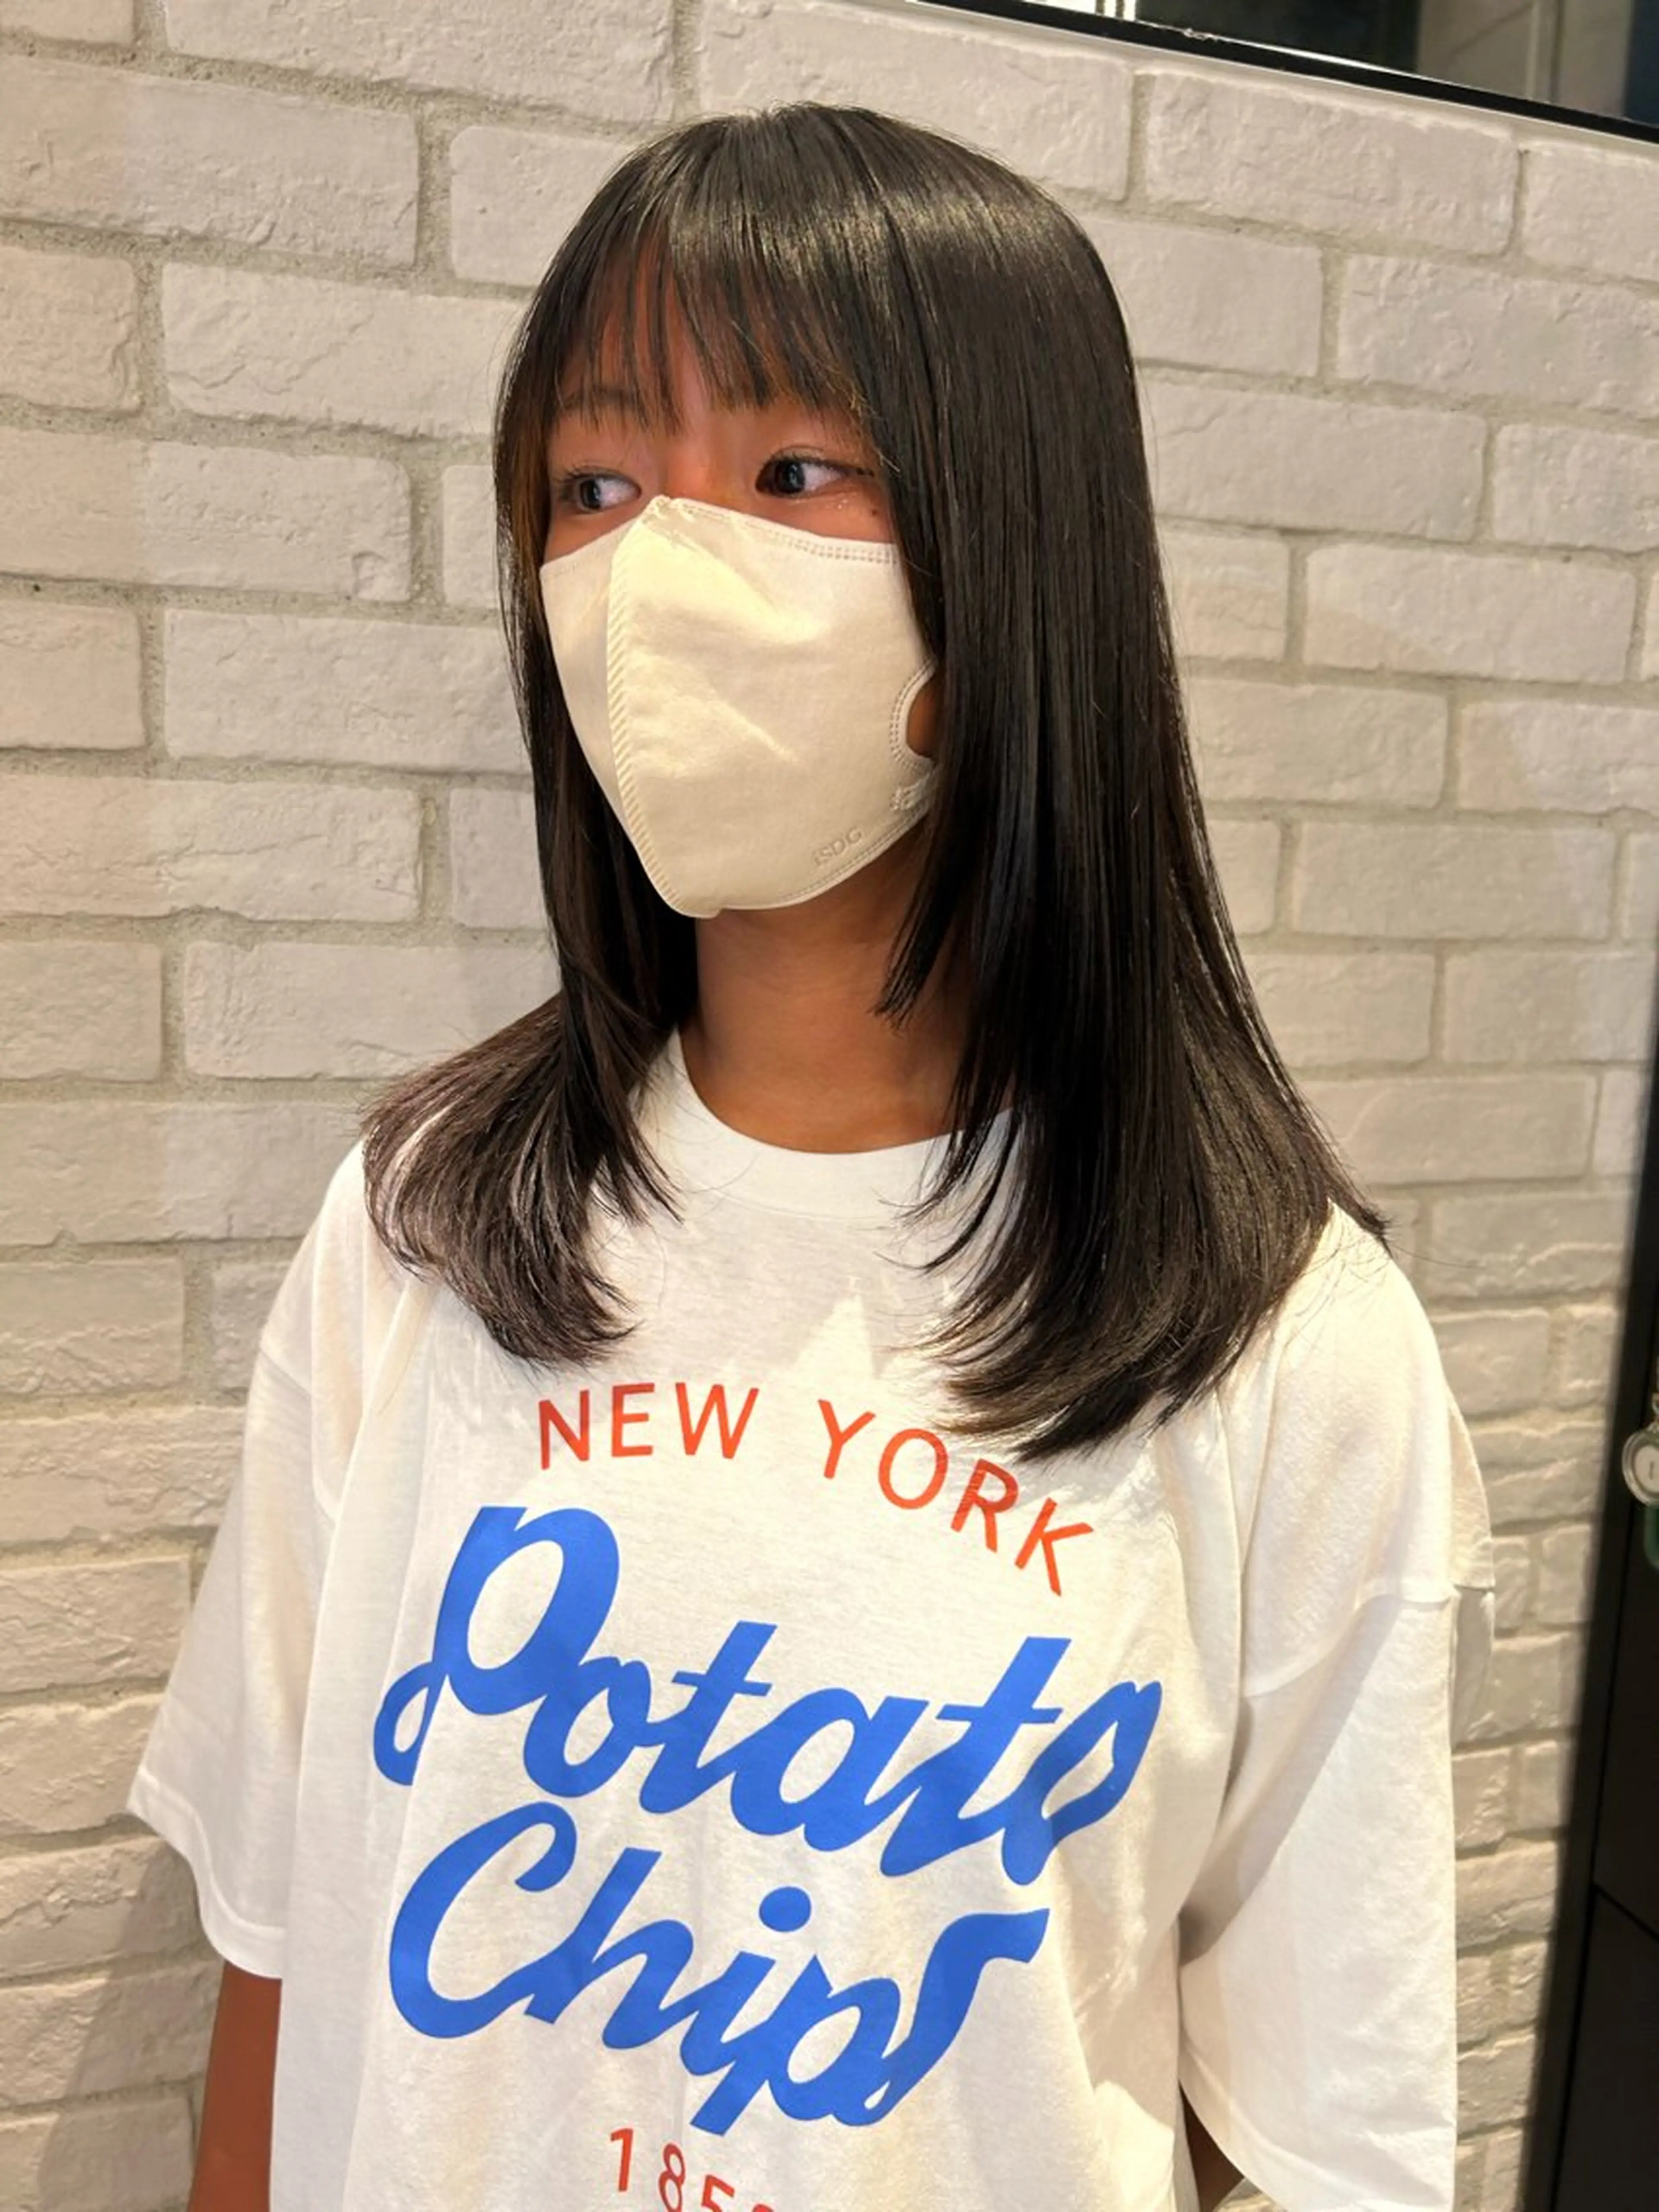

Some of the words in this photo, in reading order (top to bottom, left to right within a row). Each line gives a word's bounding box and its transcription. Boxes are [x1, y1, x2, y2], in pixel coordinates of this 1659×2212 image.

[539, 1382, 759, 1469] NEW
[818, 1399, 1094, 1596] YORK
[374, 1506, 1163, 1885] Potato
[389, 1802, 1050, 2136] Chips
